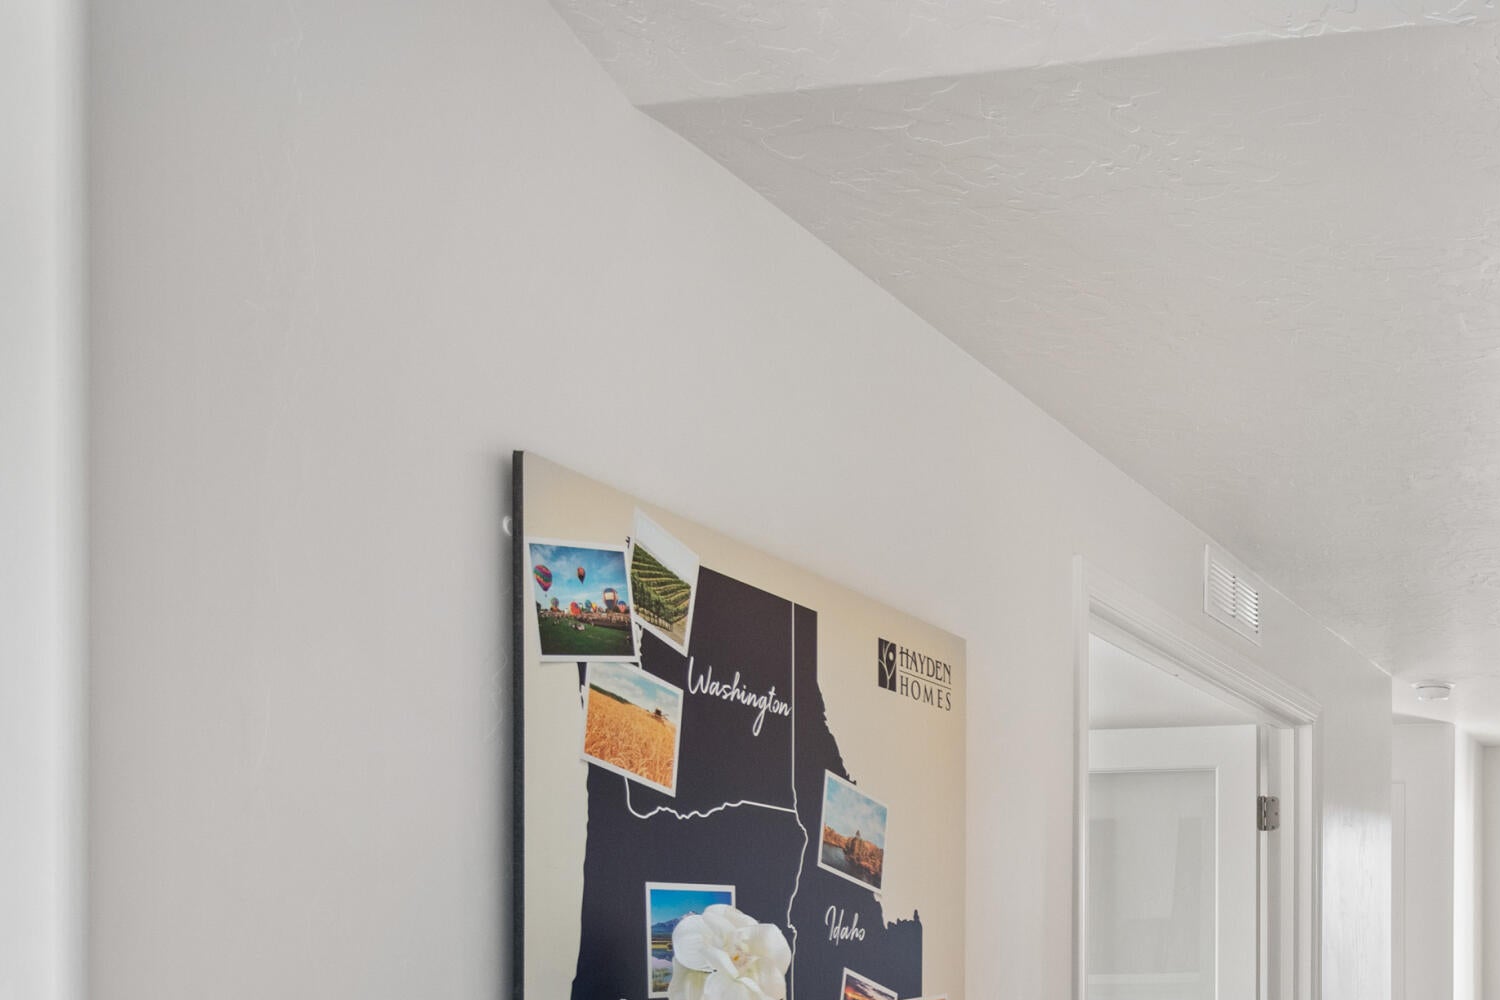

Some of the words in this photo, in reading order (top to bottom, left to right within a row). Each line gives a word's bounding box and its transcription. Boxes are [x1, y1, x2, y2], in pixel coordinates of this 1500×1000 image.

[899, 645, 952, 686] HAYDEN
[687, 656, 791, 737] Washington
[899, 676, 952, 712] HOMES
[824, 905, 866, 943] Idaho
